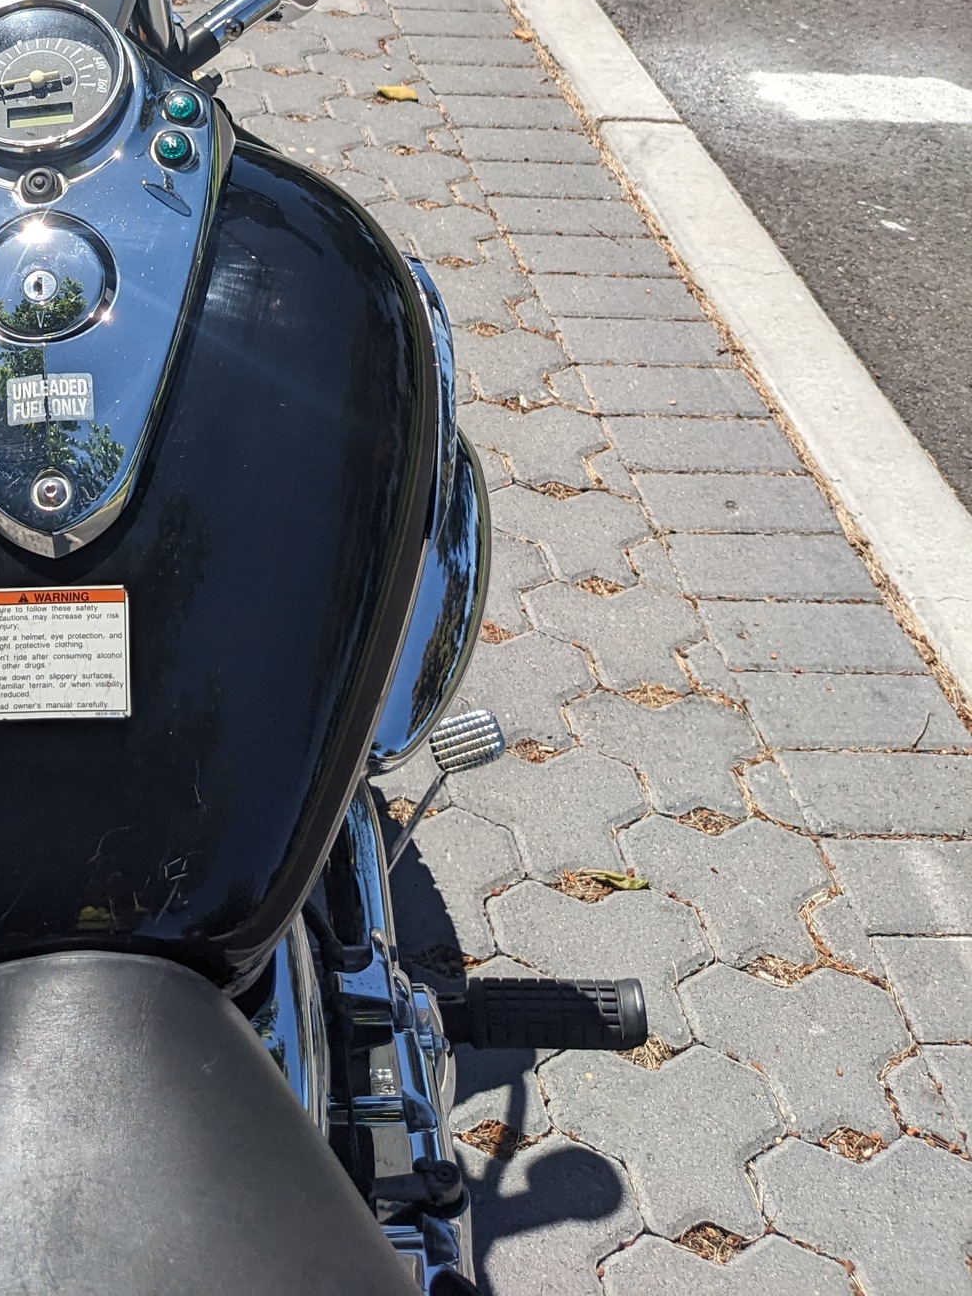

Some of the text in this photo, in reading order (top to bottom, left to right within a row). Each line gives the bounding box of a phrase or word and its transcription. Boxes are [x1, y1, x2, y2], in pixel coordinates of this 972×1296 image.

[92, 56, 107, 70] 140
[97, 77, 108, 93] 160
[168, 139, 177, 149] N
[12, 378, 88, 401] UNLEADED
[12, 397, 88, 421] FUEL ONLY
[34, 592, 89, 602] WARNING
[15, 641, 50, 649] protective
[55, 641, 84, 649] clothing.
[49, 672, 77, 681] slippery
[95, 680, 123, 688] visibility
[77, 701, 109, 709] carefully.
